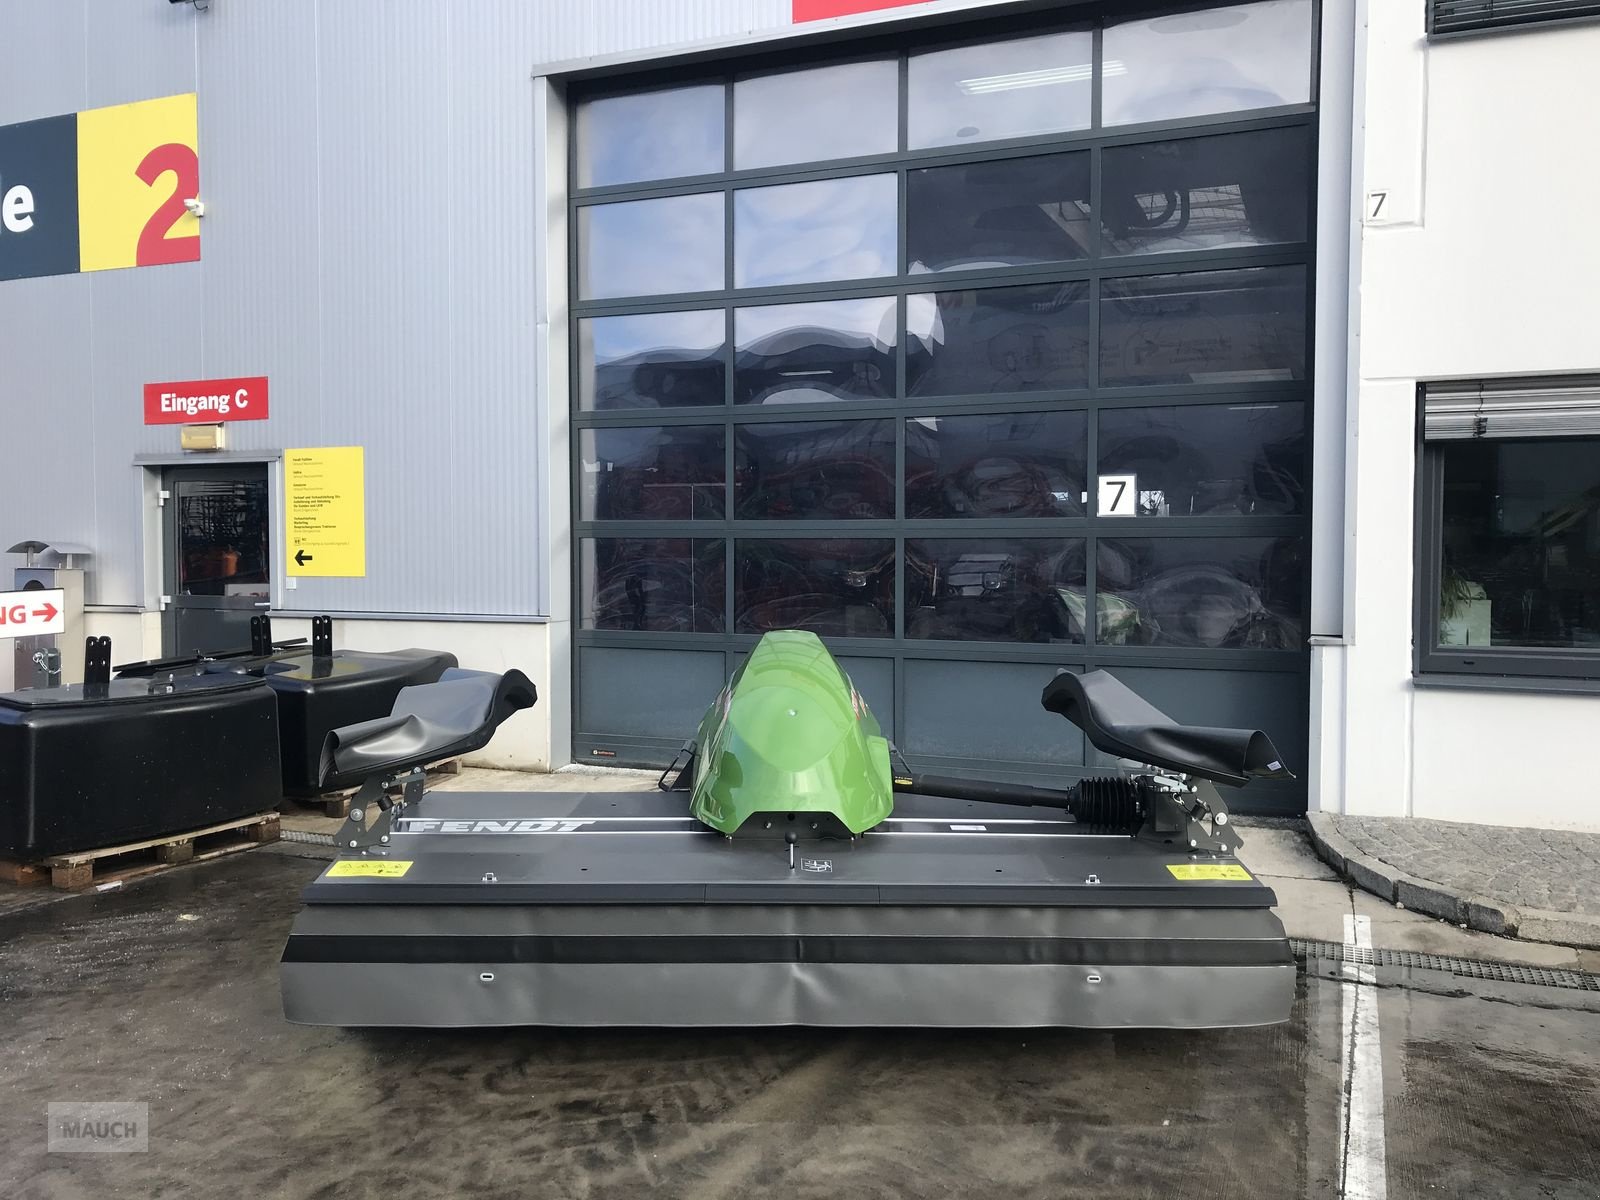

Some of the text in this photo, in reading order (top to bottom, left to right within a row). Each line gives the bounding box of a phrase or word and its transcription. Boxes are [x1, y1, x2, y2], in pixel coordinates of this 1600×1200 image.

[135, 143, 200, 267] 2
[1371, 193, 1387, 217] 7
[160, 388, 249, 416] Eingang C
[1106, 481, 1127, 512] 7
[408, 820, 596, 832] FENDT
